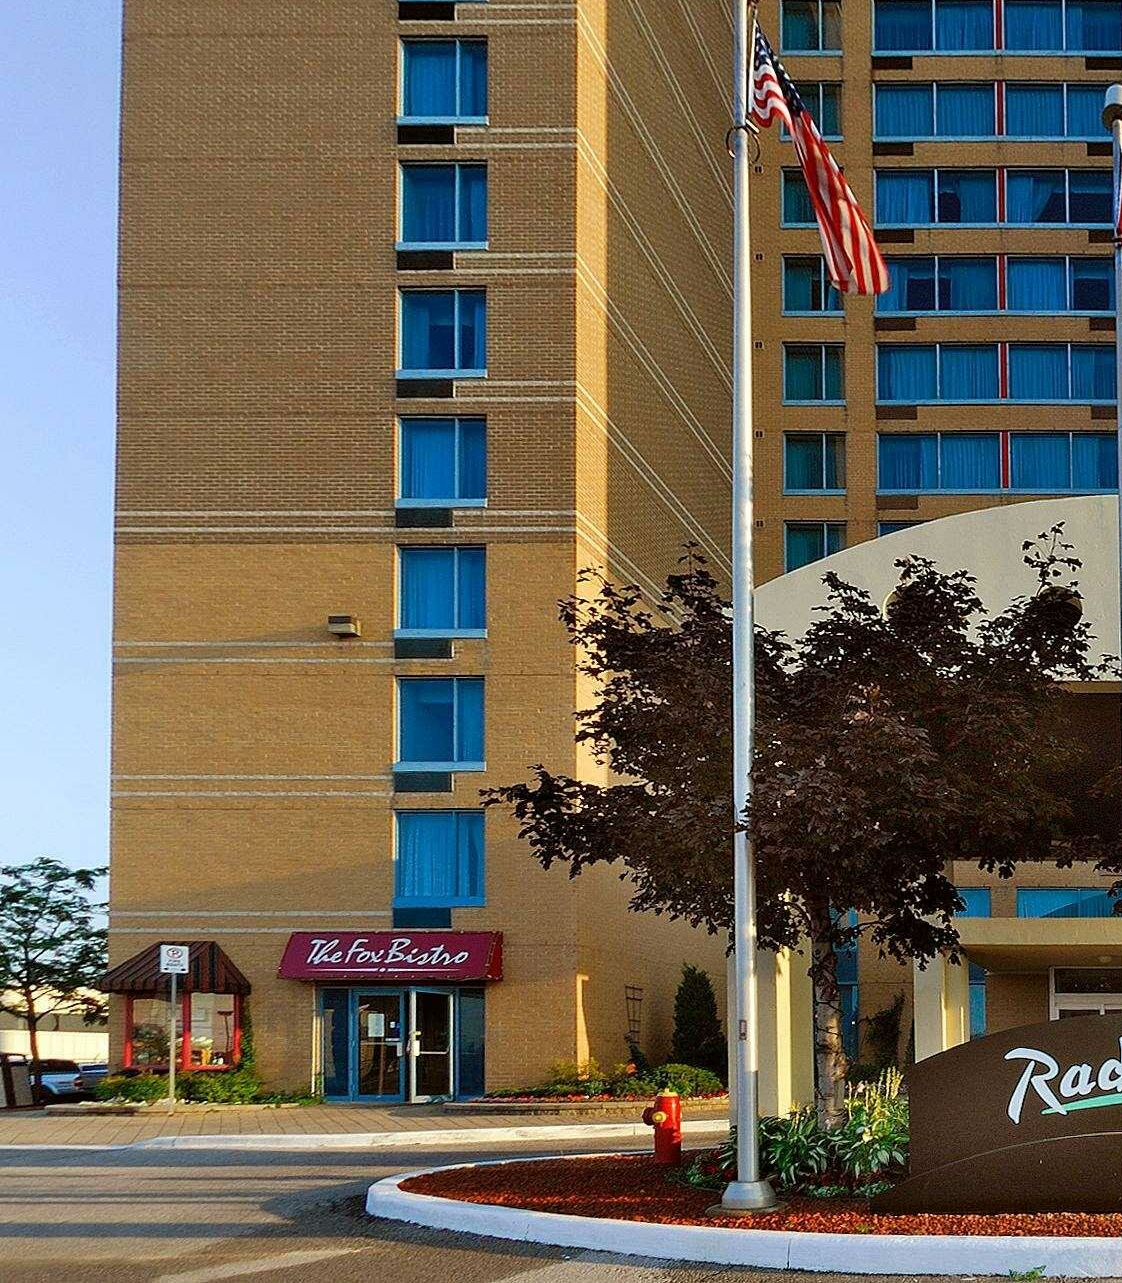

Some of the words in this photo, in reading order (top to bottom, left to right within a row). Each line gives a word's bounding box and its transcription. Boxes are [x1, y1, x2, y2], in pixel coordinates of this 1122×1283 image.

[306, 939, 343, 965] The
[345, 939, 384, 963] Fox
[384, 938, 469, 965] Bistro
